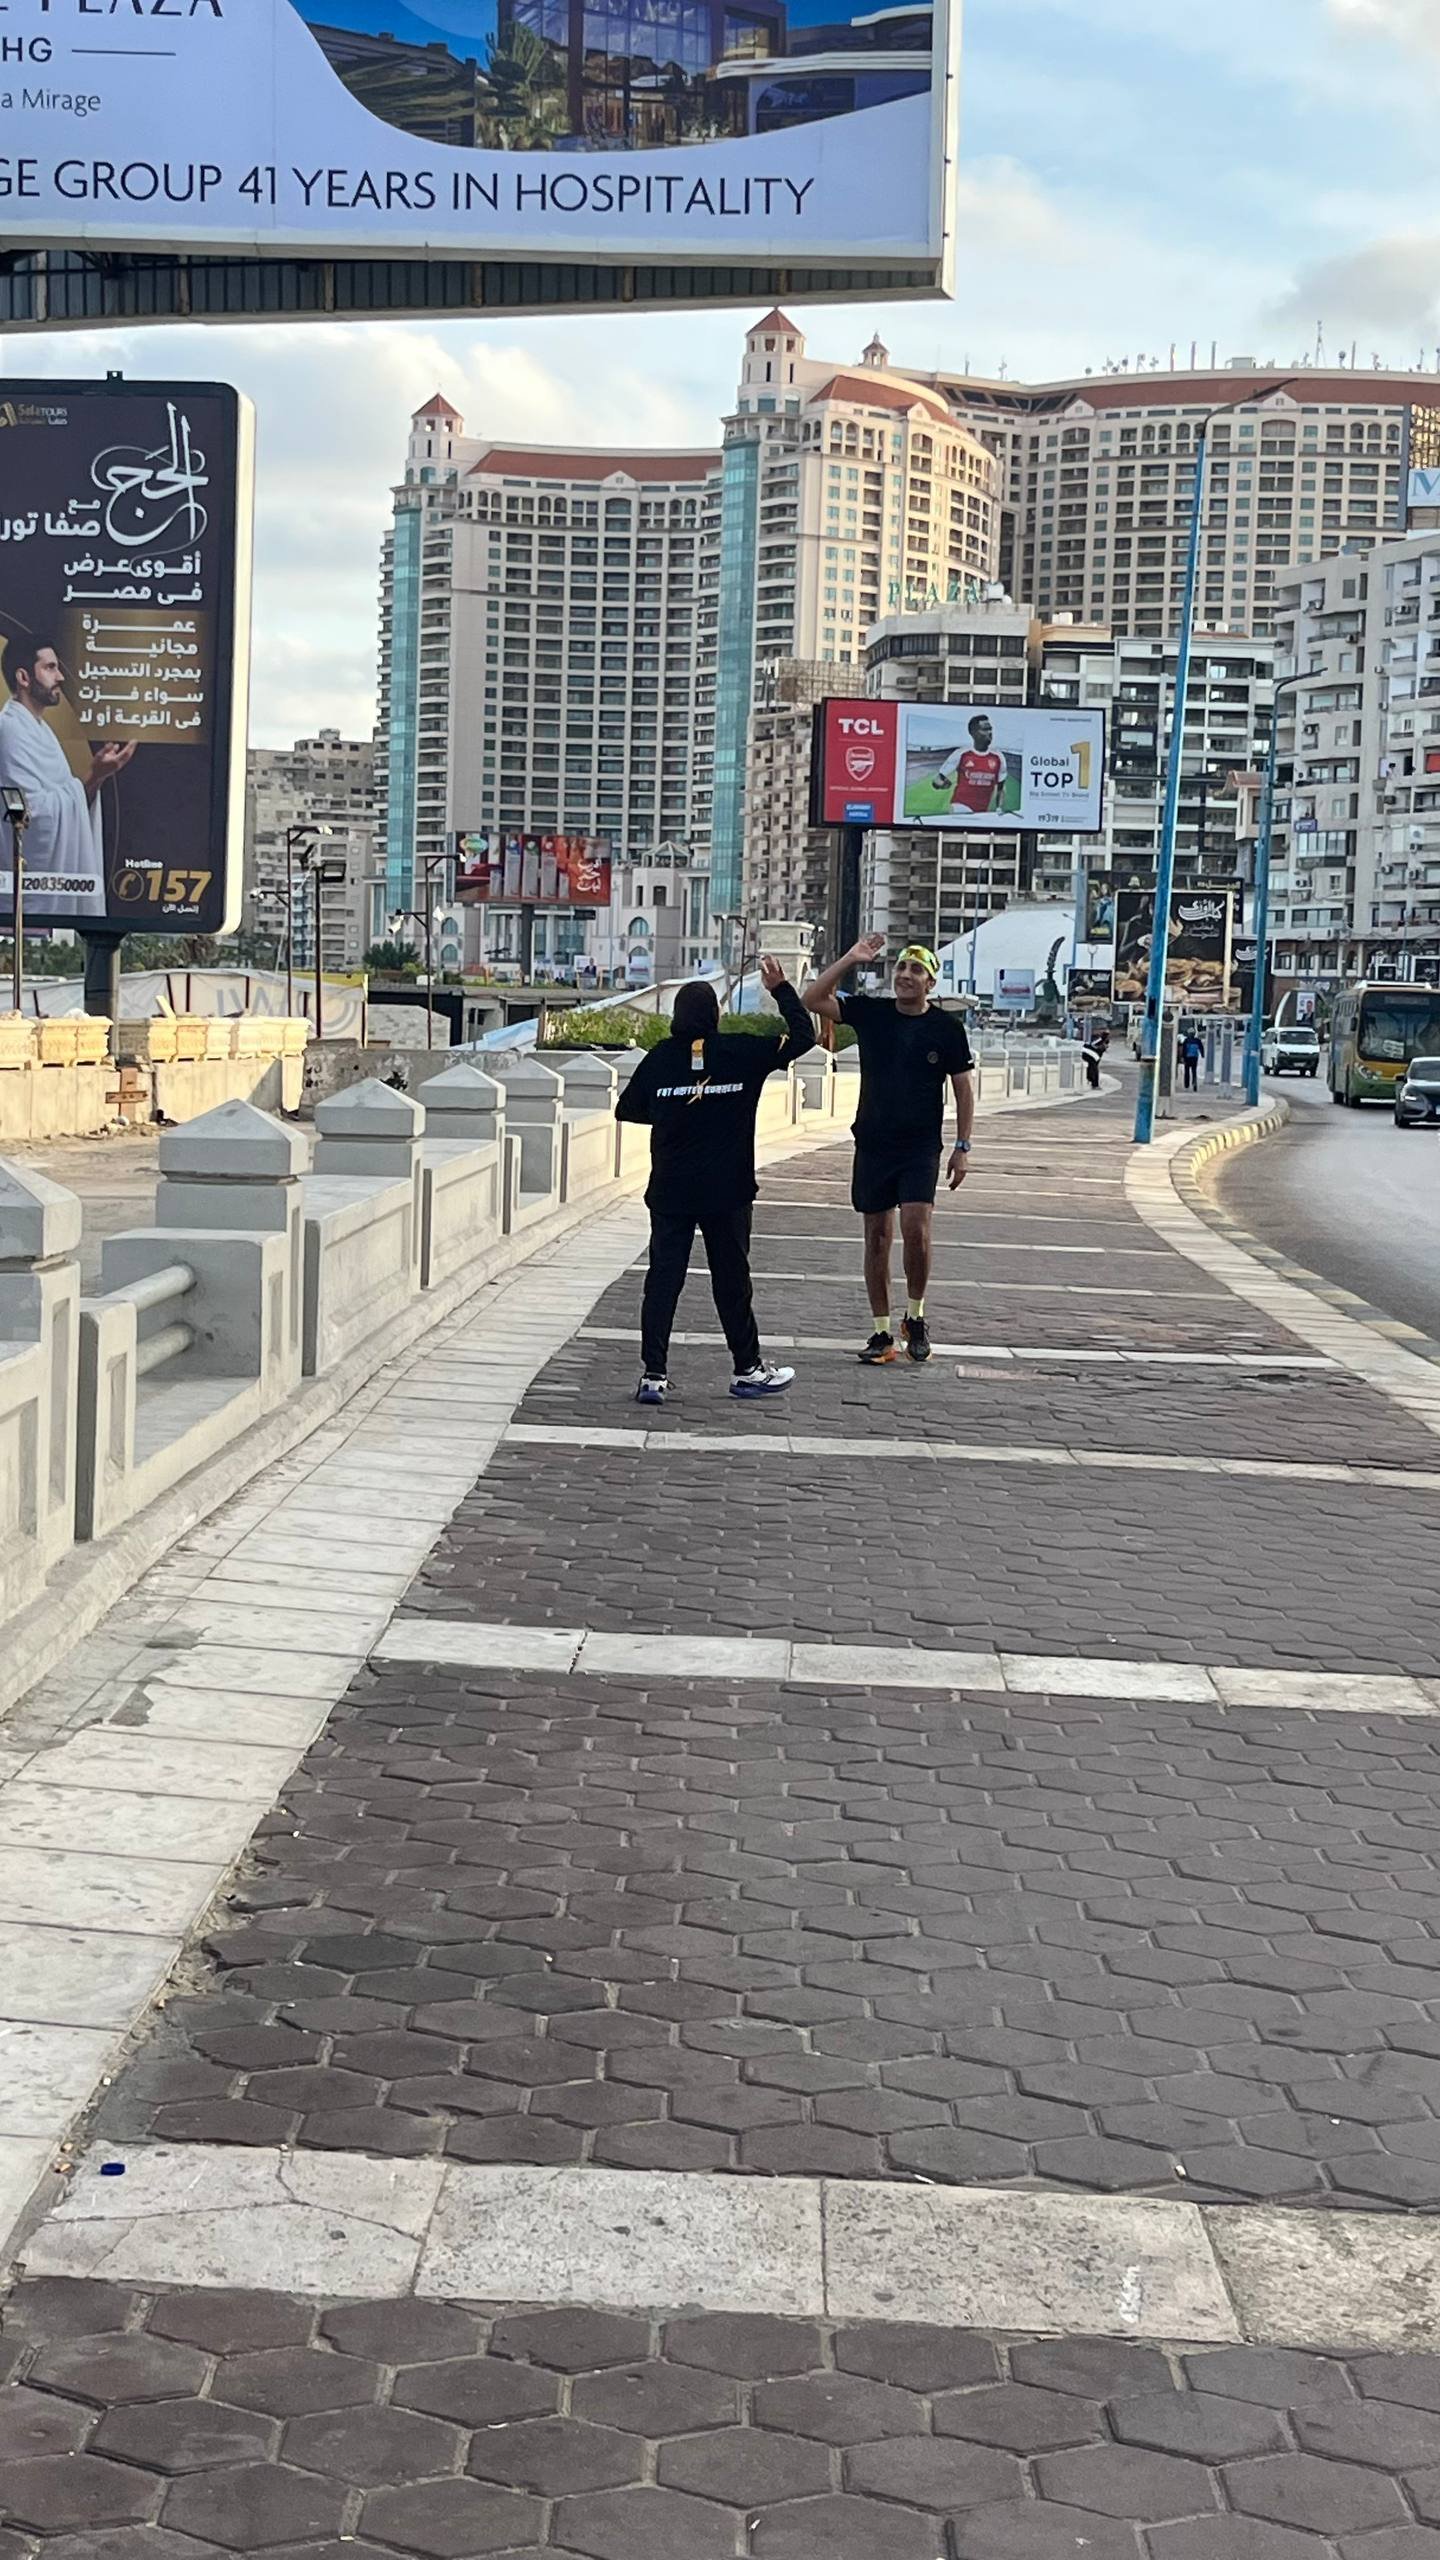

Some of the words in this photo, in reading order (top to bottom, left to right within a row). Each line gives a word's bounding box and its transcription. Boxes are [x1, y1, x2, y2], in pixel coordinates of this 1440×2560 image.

[22, 88, 102, 115] Mirage
[53, 158, 223, 203] GROUP
[238, 166, 277, 205] 41
[292, 167, 437, 211] YEARS
[452, 171, 499, 211] IN
[516, 172, 815, 216] HOSPITALITY
[67, 497, 101, 515] مع
[44, 512, 101, 538] صفا
[63, 552, 131, 578] عرض
[134, 550, 201, 579] أقوى
[62, 583, 152, 603] مصر
[82, 613, 196, 634] عمرة
[86, 635, 198, 659] مجانية
[78, 661, 151, 681] التسجيل
[153, 665, 202, 684] بمجرد
[78, 685, 140, 704] فزت
[143, 686, 204, 706] سواء
[79, 707, 93, 724] لا
[96, 704, 111, 728] أو
[114, 708, 171, 728] القرعة
[837, 718, 885, 736] TCL
[1030, 755, 1070, 767] Global
[1030, 771, 1074, 788] TOP
[1069, 741, 1091, 790] 1
